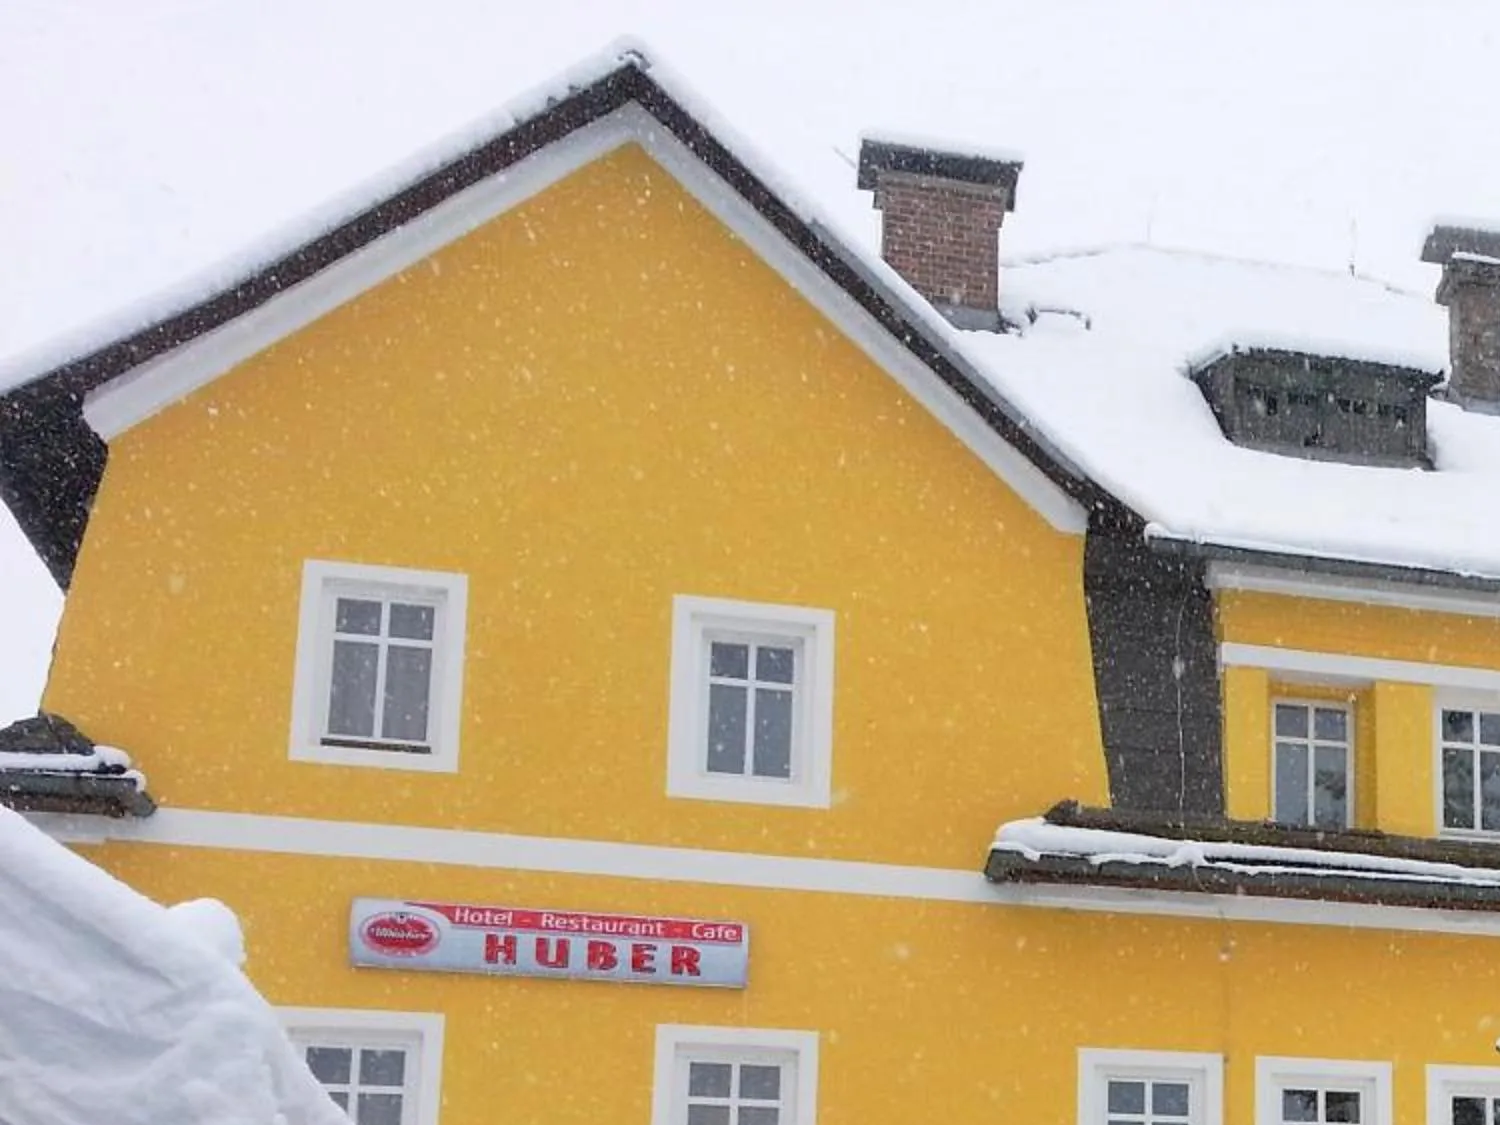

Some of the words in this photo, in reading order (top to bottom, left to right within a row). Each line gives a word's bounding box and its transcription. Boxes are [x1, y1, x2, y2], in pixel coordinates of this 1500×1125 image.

[454, 907, 513, 926] Hotel
[541, 912, 665, 936] Restaurant
[691, 923, 737, 940] Cafe
[484, 932, 702, 977] HUBER
